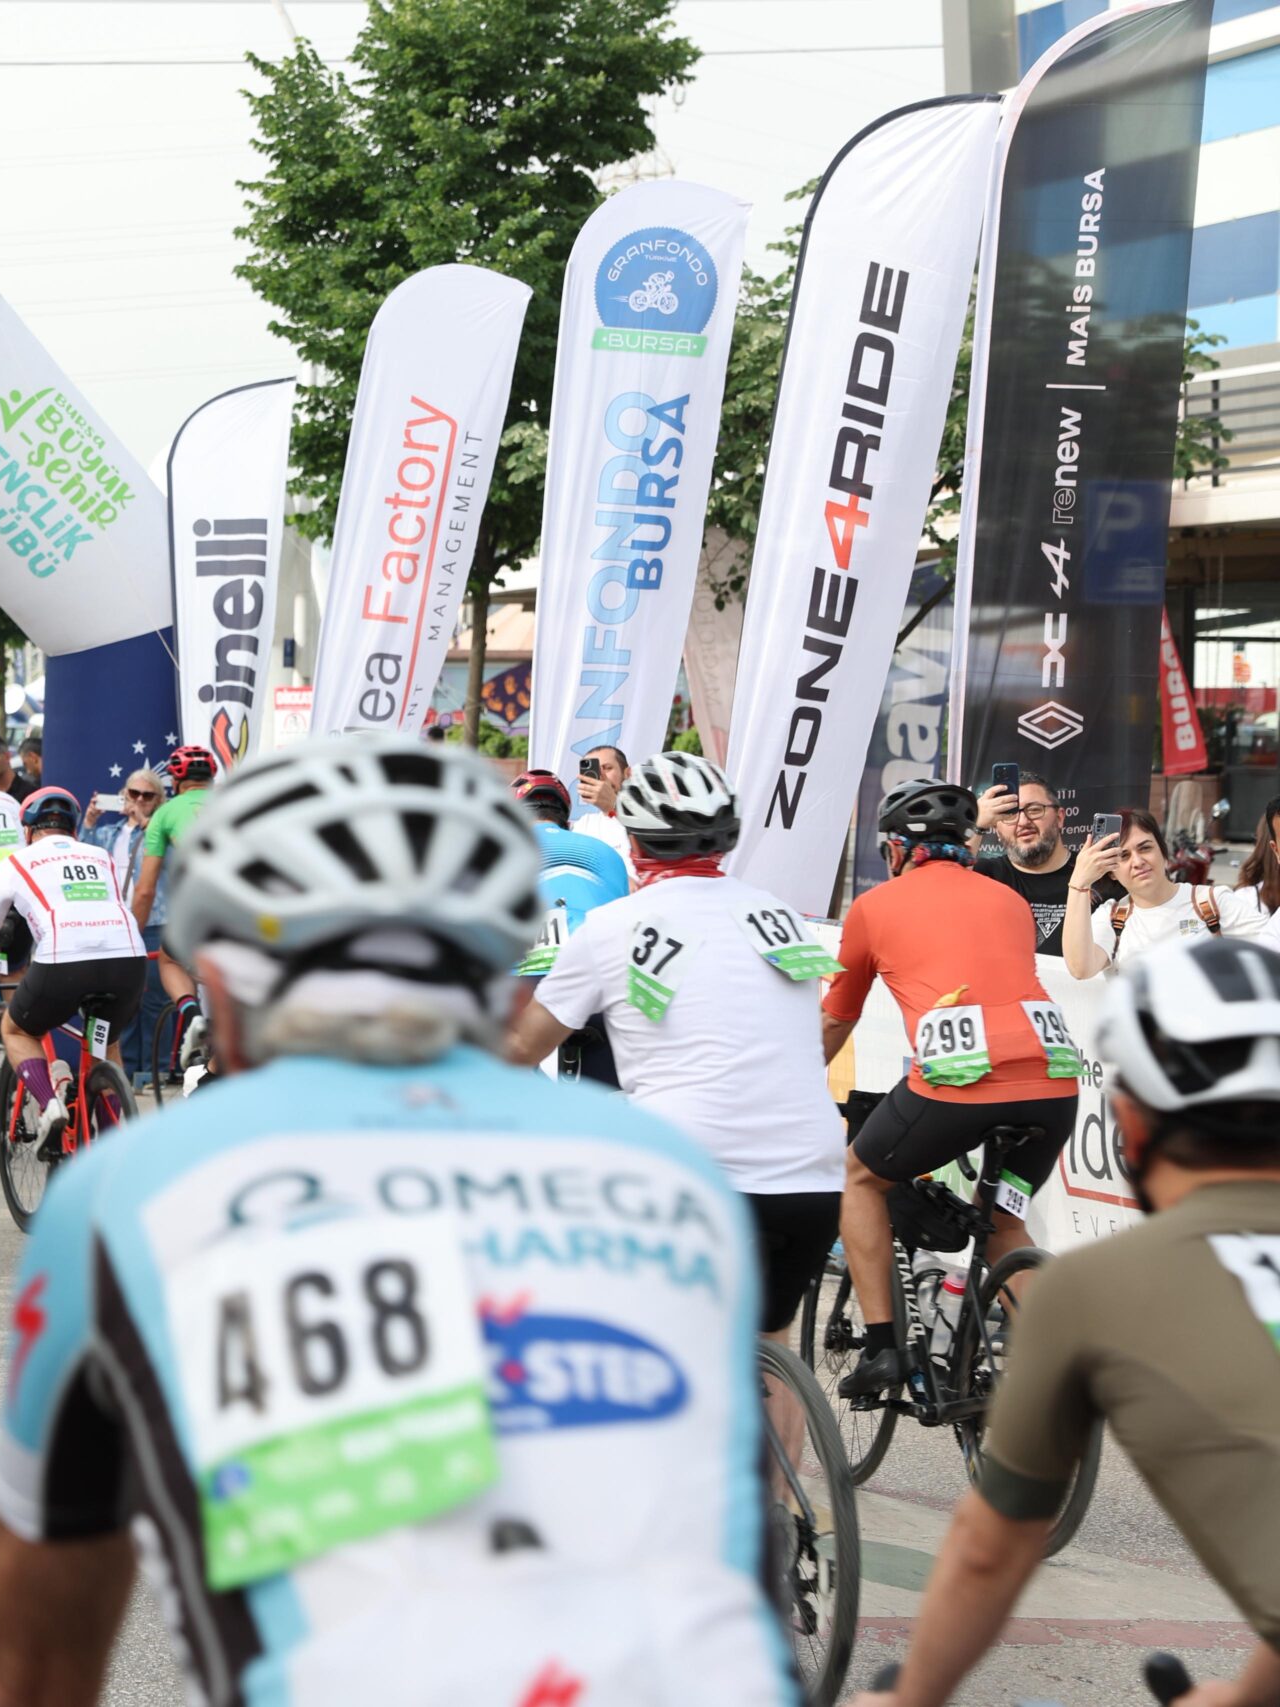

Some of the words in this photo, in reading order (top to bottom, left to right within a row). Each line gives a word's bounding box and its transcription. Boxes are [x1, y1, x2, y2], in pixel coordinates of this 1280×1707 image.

[1075, 168, 1105, 277] BURSA
[608, 240, 708, 286] GRANFONDO
[608, 333, 691, 352] BURSA
[627, 393, 690, 590] BURSA
[1053, 407, 1082, 524] renew
[362, 395, 458, 624] Factory
[428, 432, 483, 640] MANAGEMENT
[764, 261, 910, 830] ZONE4RIDE
[1061, 825, 1094, 834] renau
[63, 865, 99, 881] 489
[632, 922, 684, 976] 37
[746, 909, 803, 947] 137
[94, 1024, 107, 1045] 489
[921, 1017, 977, 1057] 299
[376, 1168, 722, 1247] OMEGA
[462, 1226, 720, 1298] HARMA
[216, 1256, 433, 1415] 468
